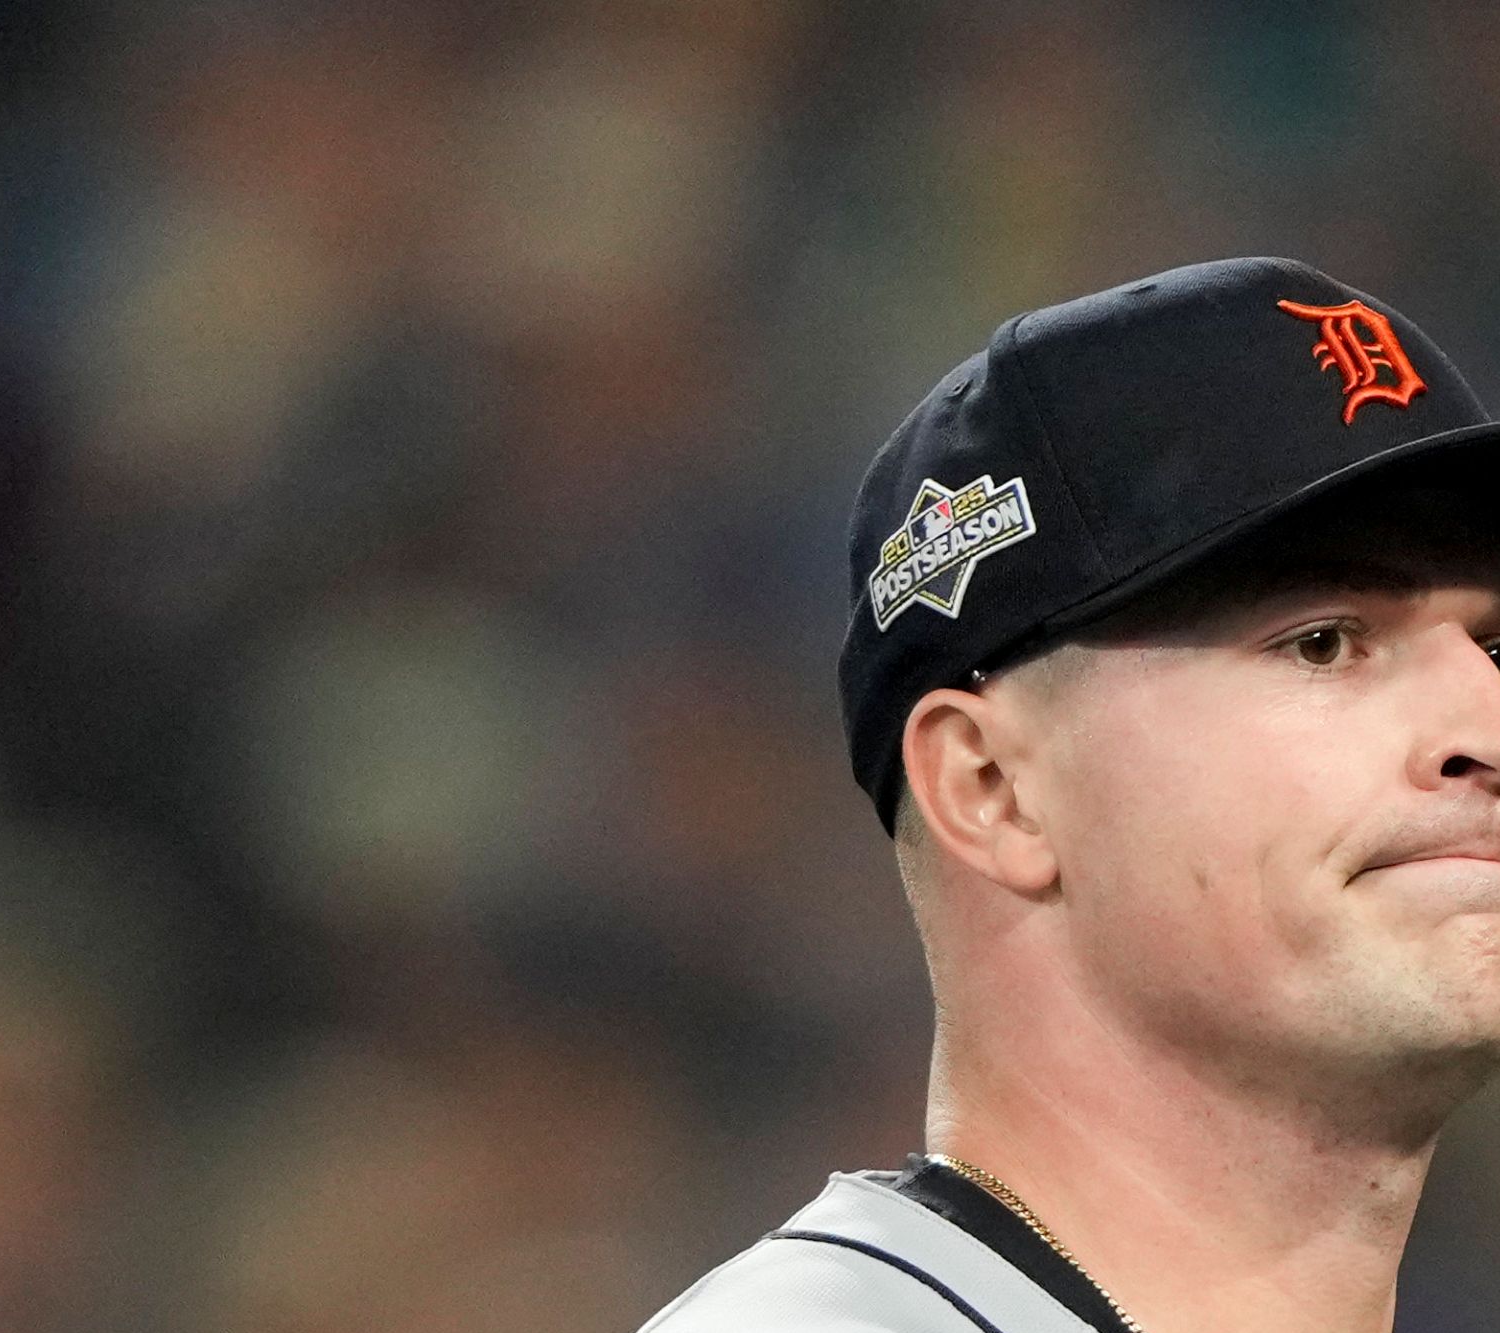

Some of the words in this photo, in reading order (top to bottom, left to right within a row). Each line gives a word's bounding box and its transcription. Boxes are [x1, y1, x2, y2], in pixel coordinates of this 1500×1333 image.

[1276, 299, 1428, 426] D
[872, 498, 1023, 612] POSTSEASON
[883, 533, 910, 564] 20
[954, 486, 986, 515] 25
